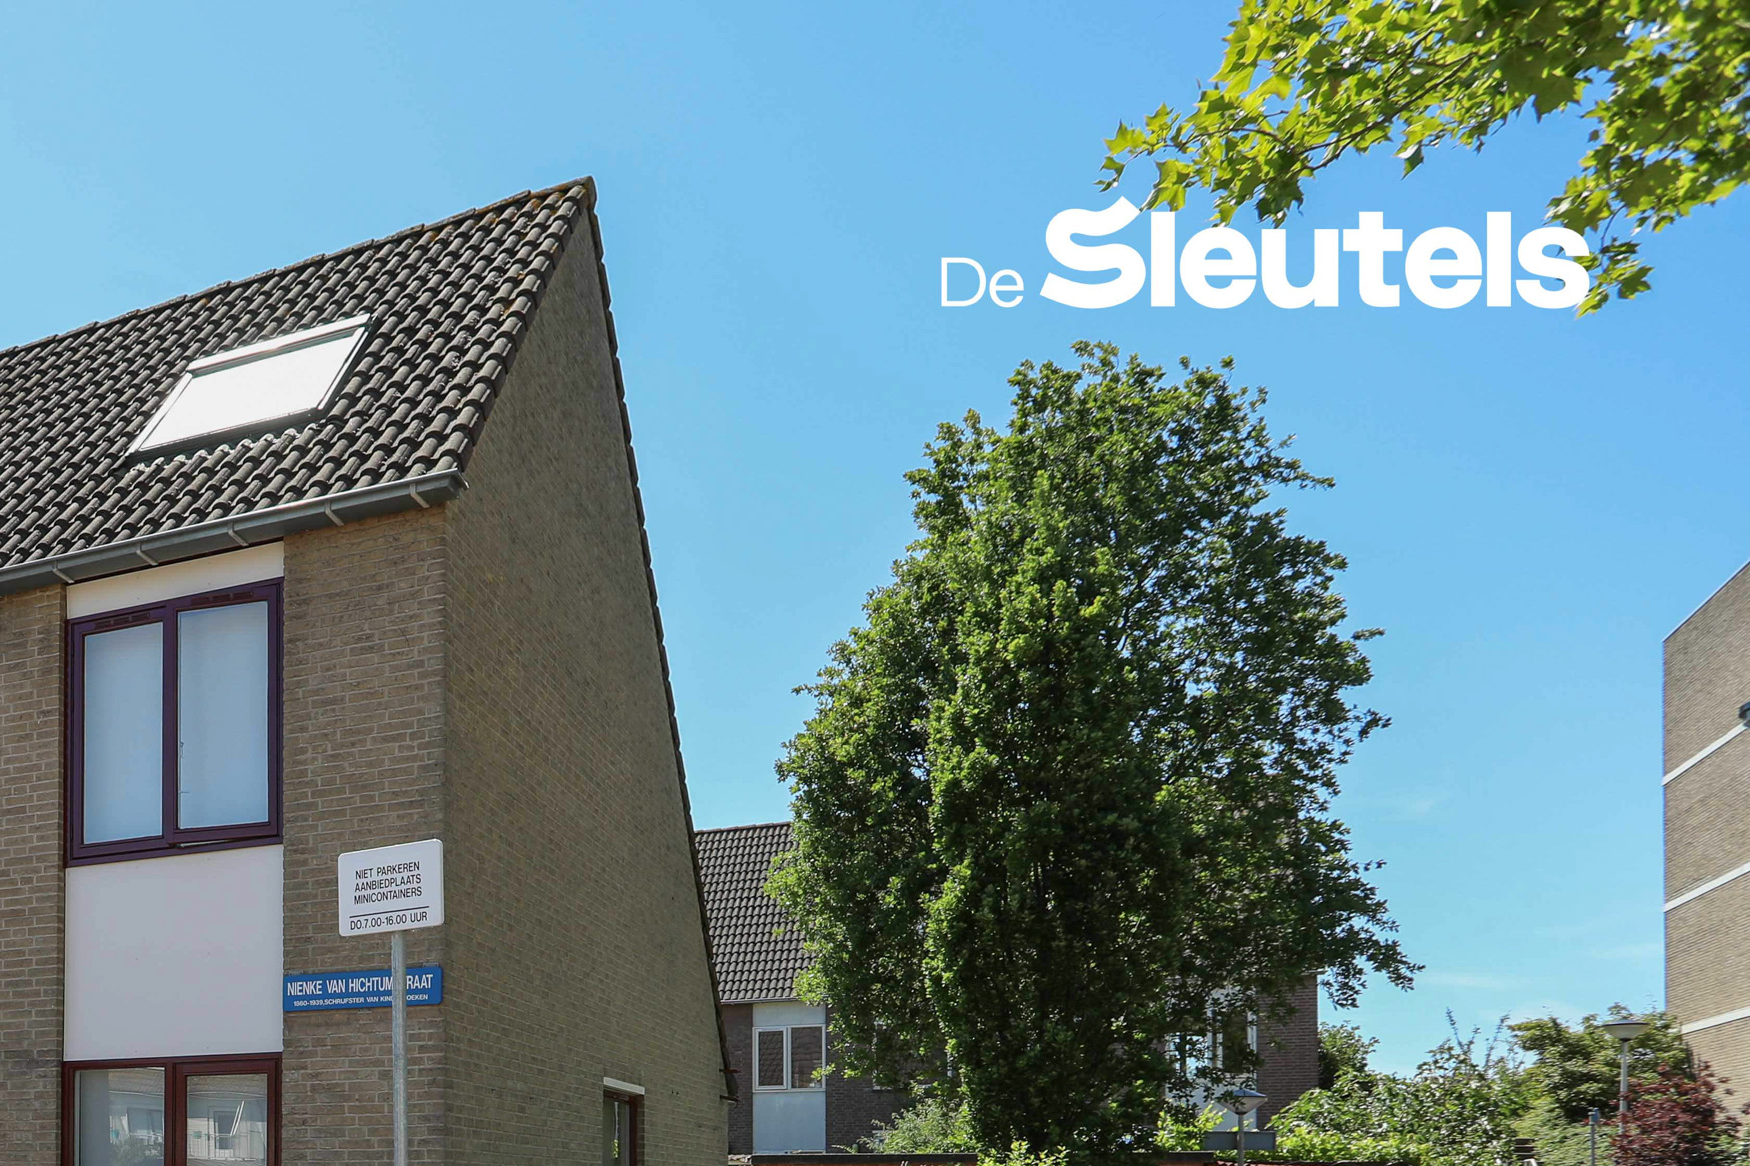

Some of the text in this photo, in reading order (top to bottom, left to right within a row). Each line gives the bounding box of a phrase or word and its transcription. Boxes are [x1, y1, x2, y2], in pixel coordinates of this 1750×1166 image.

[355, 861, 420, 880] NIET PARKEREN
[354, 873, 422, 893] AANBIEDPLAATS
[353, 886, 423, 905] MINICONTAINERS
[350, 911, 428, 931] DO.7.00-16.00 UUR
[287, 974, 434, 996] NIENKE VAN HICHTUMRAAT
